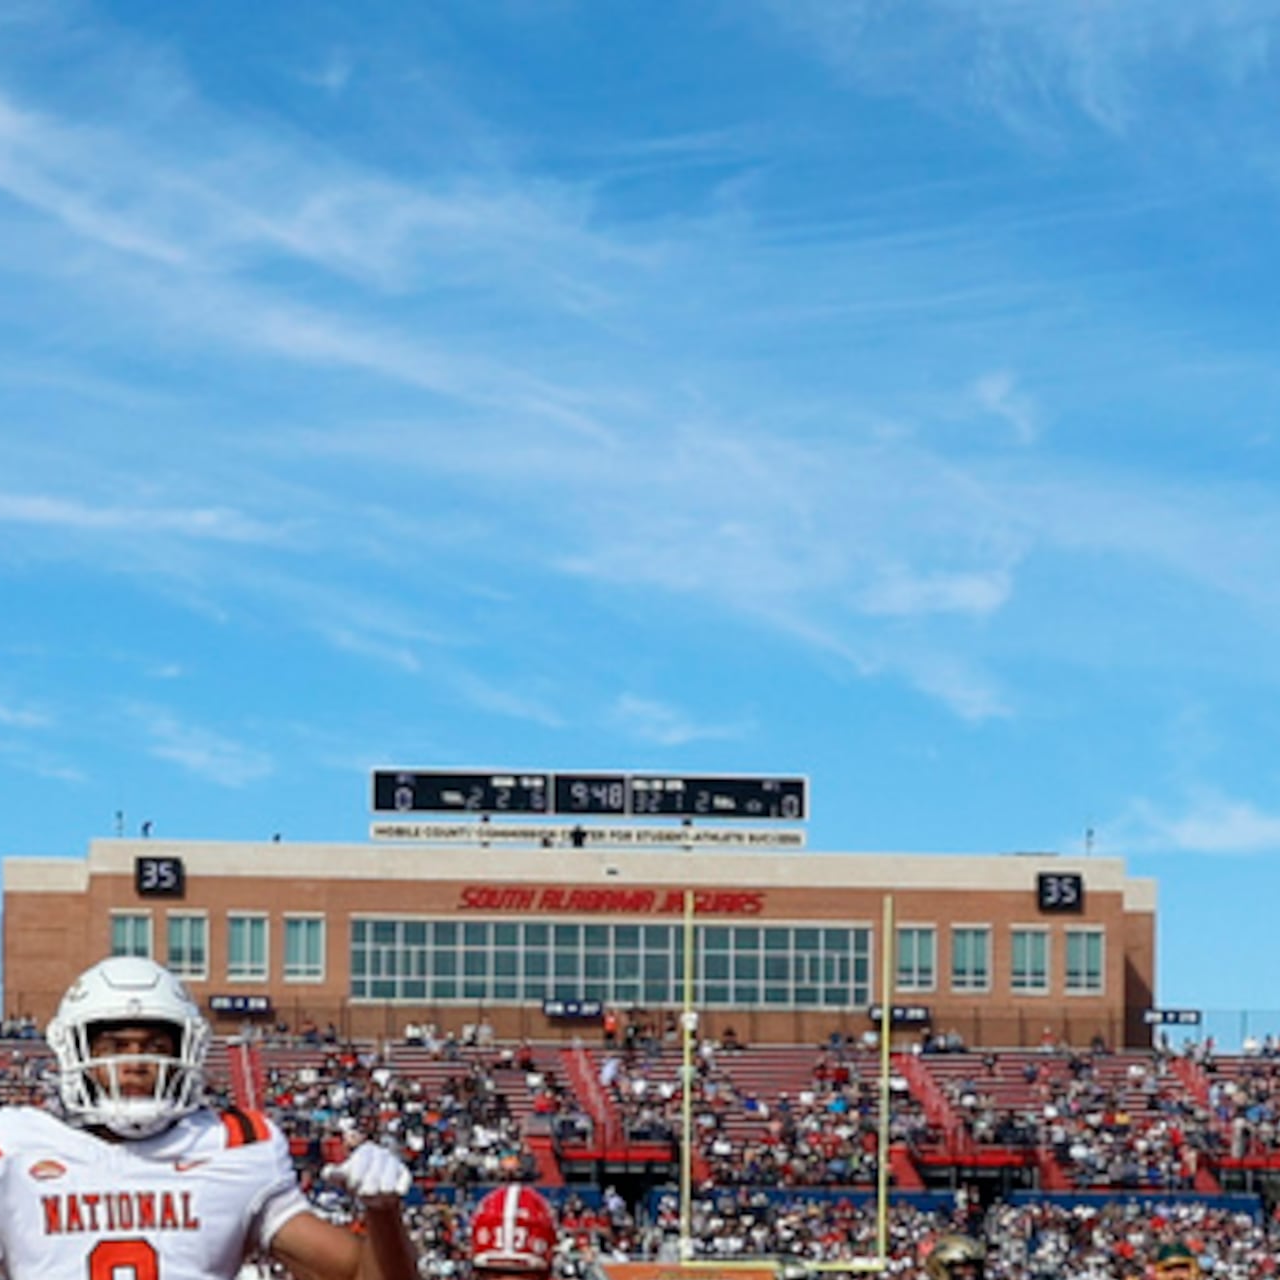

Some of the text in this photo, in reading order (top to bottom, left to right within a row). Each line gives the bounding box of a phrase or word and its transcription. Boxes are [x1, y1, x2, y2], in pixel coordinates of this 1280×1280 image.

[141, 860, 177, 888] 35
[457, 886, 535, 911] SOUTH
[538, 888, 655, 912] ALABAMA
[1042, 877, 1077, 905] 35
[41, 1190, 200, 1234] NATIONAL
